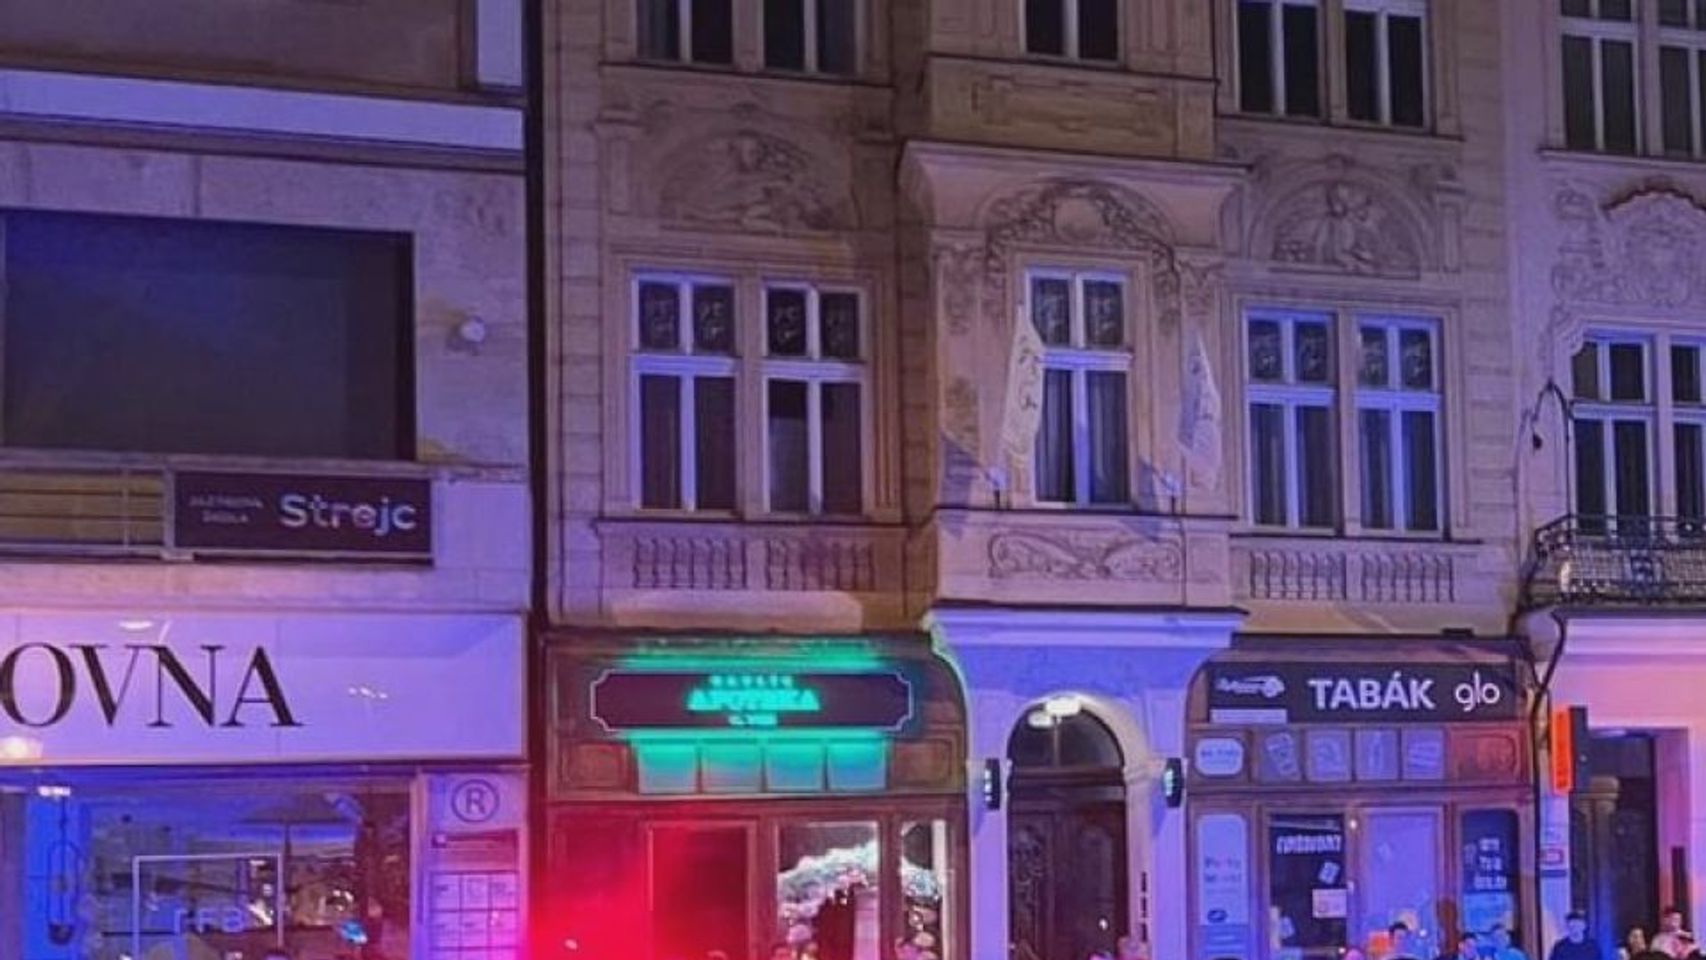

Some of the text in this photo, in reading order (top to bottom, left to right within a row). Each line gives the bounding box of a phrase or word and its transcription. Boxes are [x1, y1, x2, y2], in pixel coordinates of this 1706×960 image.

[280, 494, 416, 537] Strejc
[1, 642, 304, 729] OVNA
[1307, 672, 1436, 711] TABÁK
[1455, 671, 1500, 712] glo
